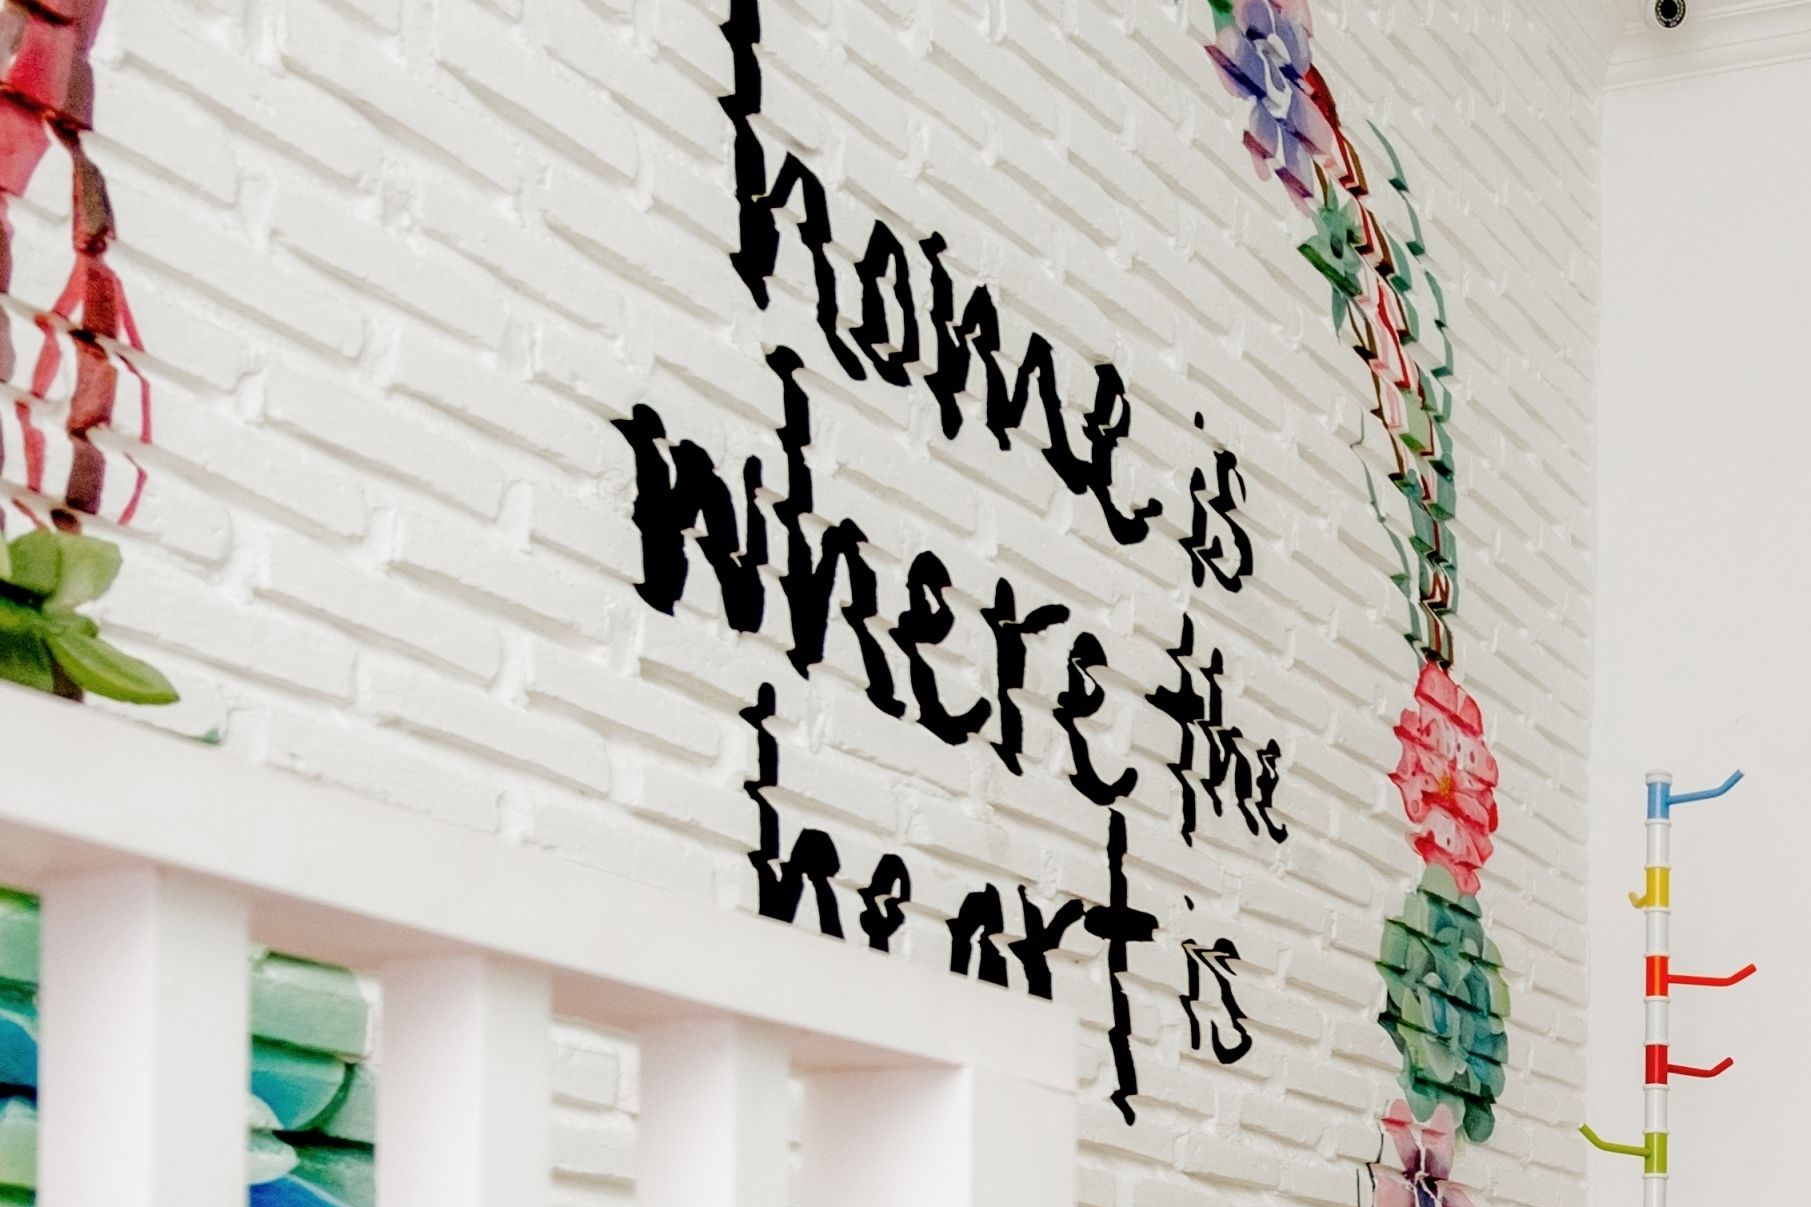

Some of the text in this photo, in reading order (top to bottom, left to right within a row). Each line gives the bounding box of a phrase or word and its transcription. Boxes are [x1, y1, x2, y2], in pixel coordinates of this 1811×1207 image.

[718, 0, 1254, 593] home is
[610, 345, 1288, 845] where the
[739, 682, 1254, 1126] heart is
